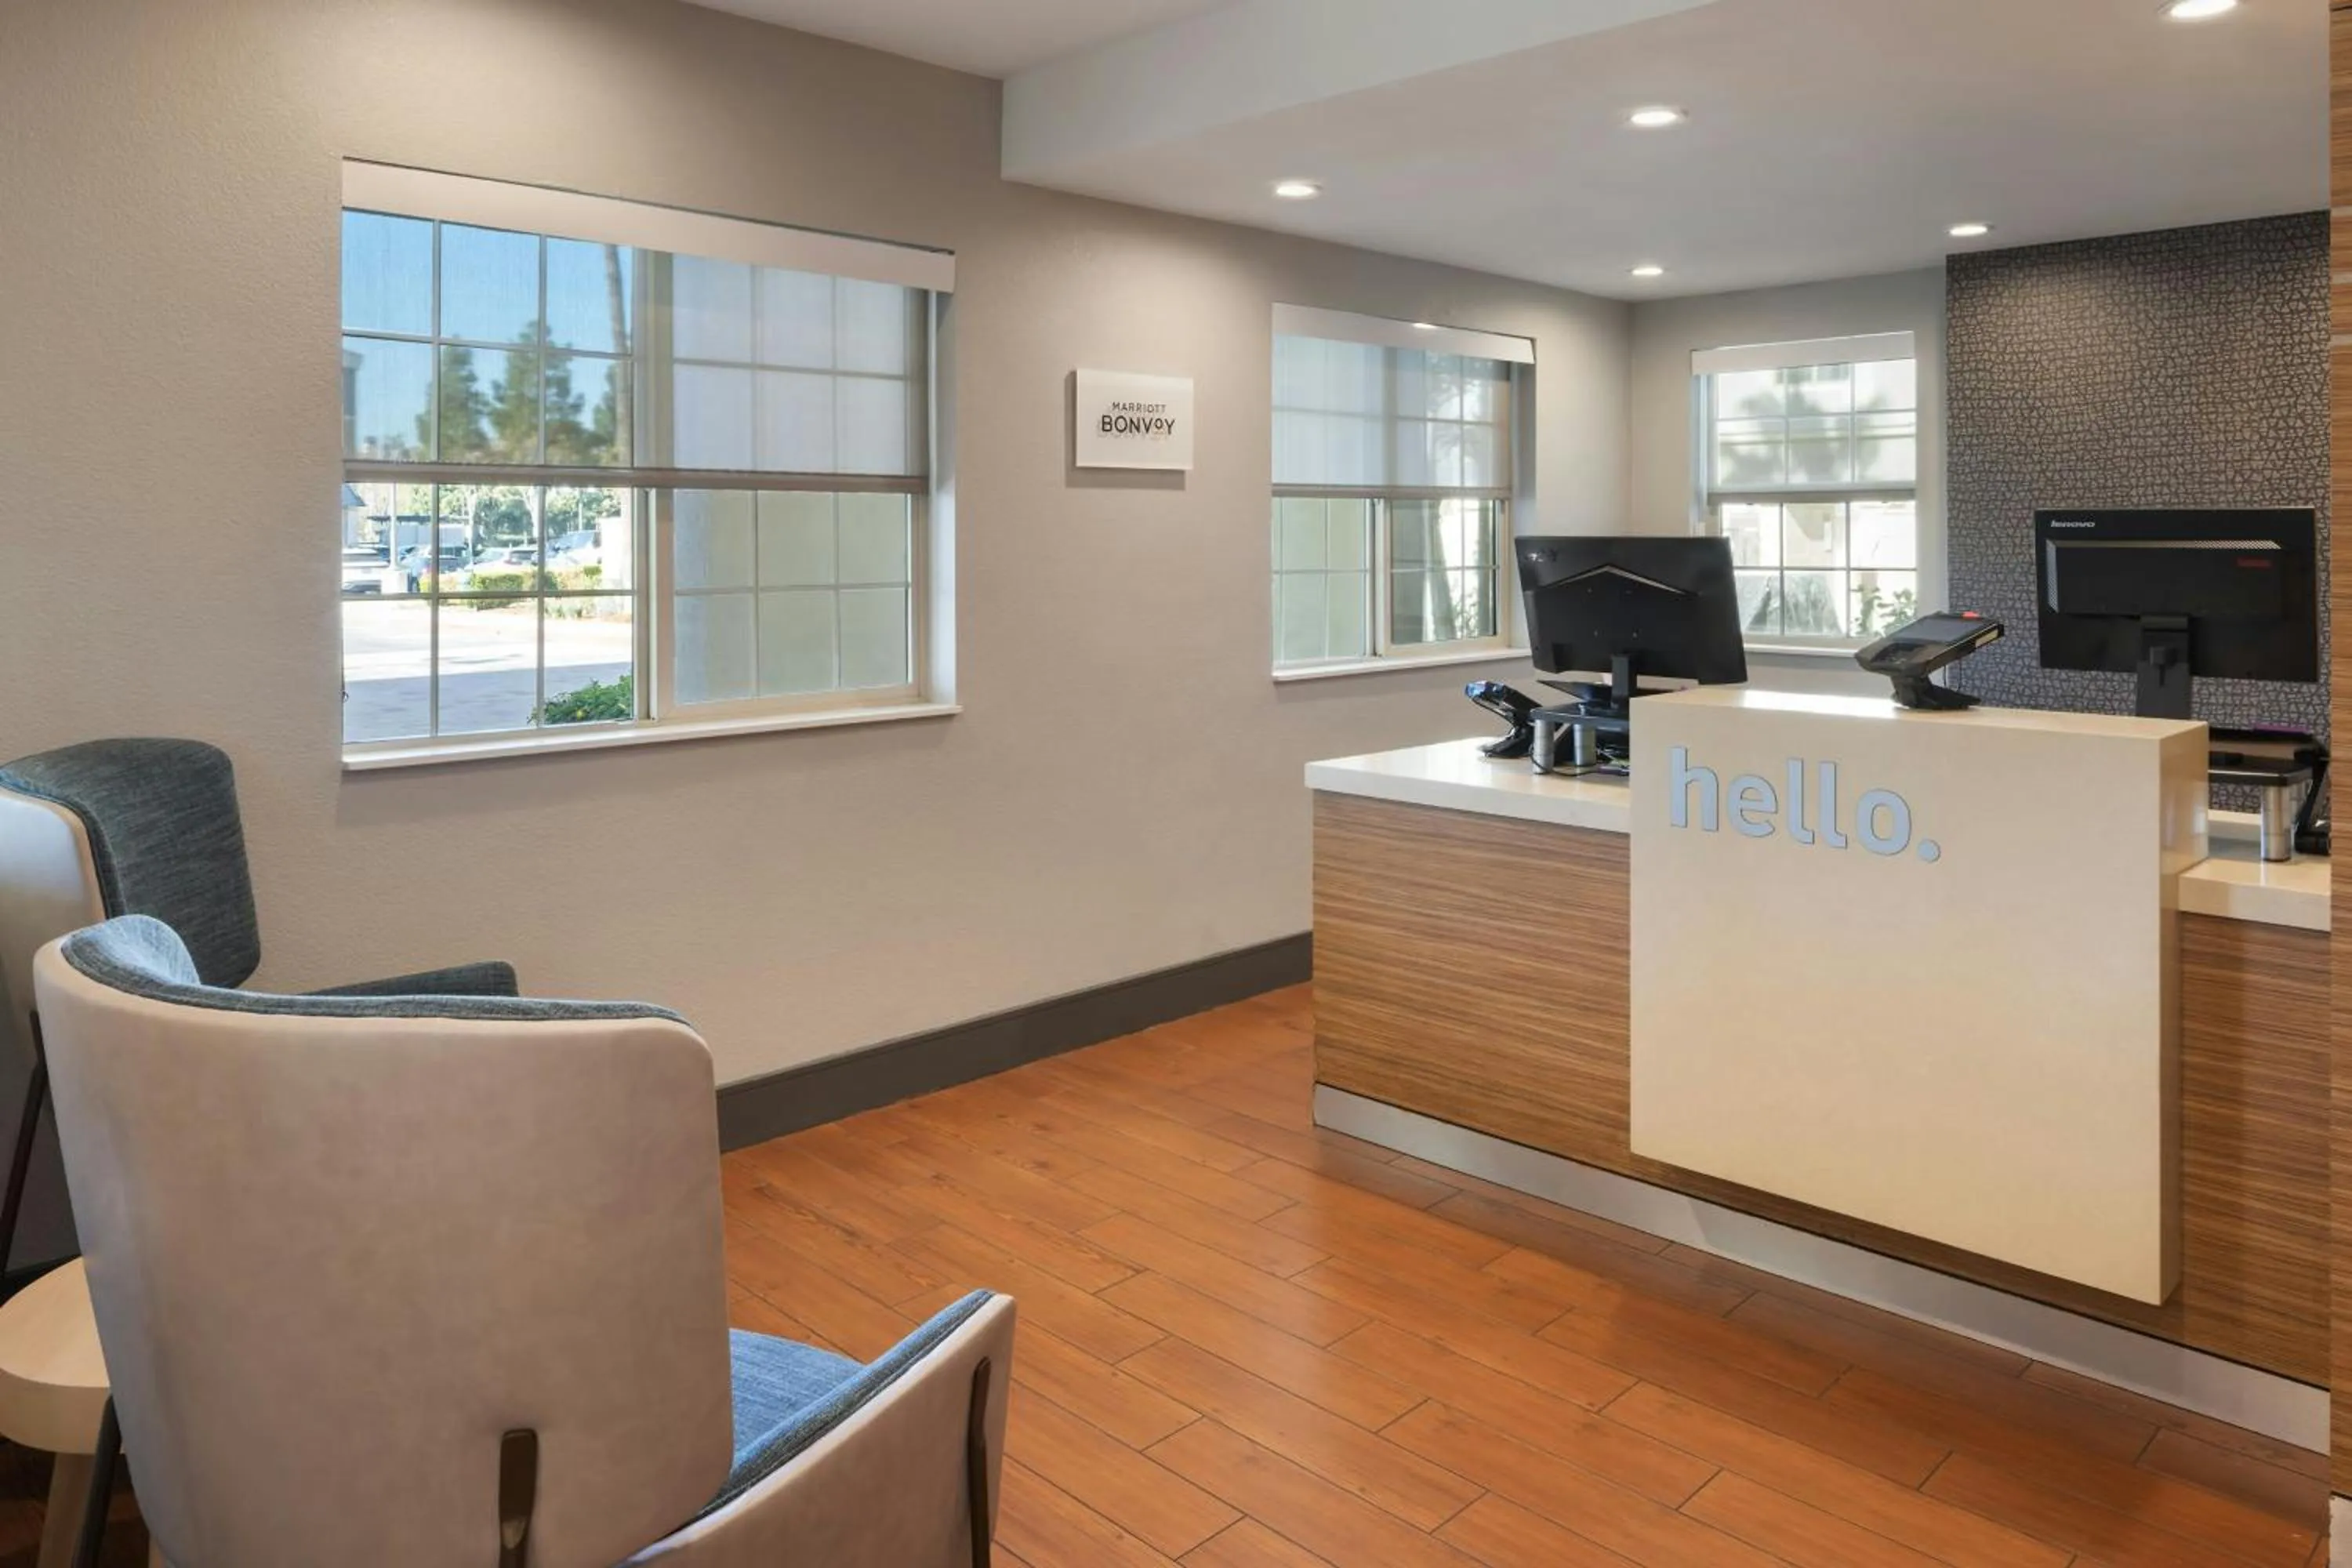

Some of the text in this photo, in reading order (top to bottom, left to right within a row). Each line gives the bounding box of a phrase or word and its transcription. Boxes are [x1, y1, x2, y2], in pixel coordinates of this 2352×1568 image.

[1112, 402, 1167, 413] MARRIOTT
[1102, 415, 1175, 435] BONVOY
[1670, 746, 1941, 862] hello.
